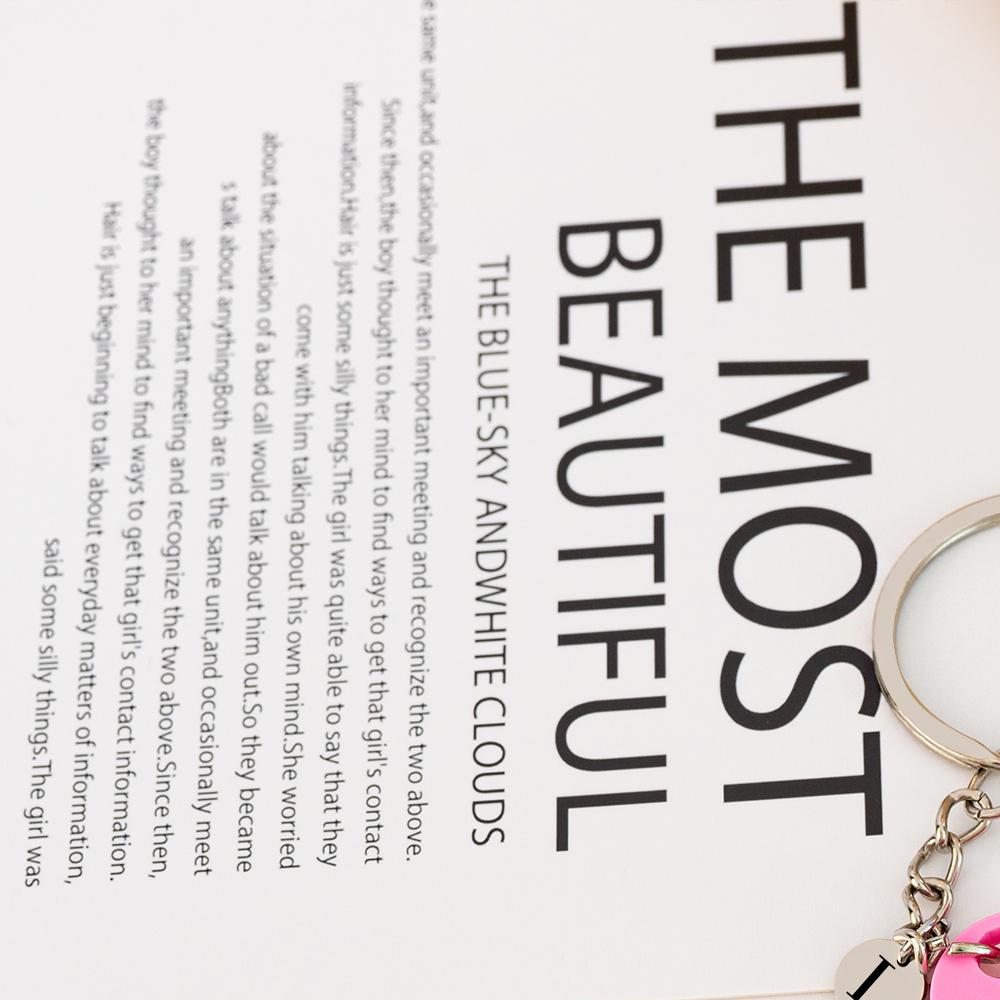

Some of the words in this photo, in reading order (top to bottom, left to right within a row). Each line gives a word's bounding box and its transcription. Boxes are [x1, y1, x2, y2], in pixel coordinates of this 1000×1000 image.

[715, 1, 866, 303] THE
[139, 258, 157, 278] to
[333, 261, 355, 295] just
[478, 256, 510, 318] THE
[137, 283, 158, 313] her
[174, 267, 193, 363] important
[416, 272, 434, 320] meet
[256, 318, 277, 336] of
[295, 304, 312, 358] come
[336, 301, 352, 354] some
[371, 280, 397, 358] thought
[416, 327, 432, 350] an
[87, 305, 117, 405] beginning
[135, 320, 155, 370] mind
[255, 343, 270, 353] a
[134, 376, 151, 395] to
[254, 359, 275, 396] bad
[294, 364, 314, 406] with
[330, 359, 355, 395] silly
[376, 365, 393, 385] to
[92, 411, 109, 431] to
[132, 401, 154, 439] find
[165, 370, 190, 451] meeting
[253, 402, 273, 434] call
[375, 391, 395, 422] her
[411, 357, 434, 454] important
[476, 329, 510, 484] BLUE-SKY
[210, 436, 227, 467] are
[293, 413, 314, 450] him
[91, 437, 109, 471] talk
[124, 445, 145, 494] ways
[169, 457, 189, 494] and
[250, 440, 271, 502] would
[374, 429, 394, 479] mind
[210, 473, 230, 490] in
[285, 457, 312, 524] talking
[373, 486, 391, 506] to
[407, 462, 432, 544] meeting
[86, 478, 108, 536] about
[128, 501, 146, 520] to
[208, 497, 229, 529] the
[249, 509, 269, 544] talk
[326, 511, 351, 543] girl
[121, 527, 143, 559] get
[160, 501, 184, 599] recognize
[372, 513, 394, 550] find
[556, 219, 667, 852] BEAUTIFUL
[43, 538, 63, 577] said
[206, 536, 222, 588] same
[288, 531, 310, 590] about
[329, 549, 345, 588] was
[411, 551, 432, 589] and
[76, 544, 103, 635] everyday
[123, 566, 145, 605] that
[246, 551, 268, 610] about
[366, 557, 386, 608] ways
[474, 498, 508, 686] ANDWHITE
[719, 359, 884, 838] MOST
[39, 584, 57, 639] some
[162, 606, 184, 639] the
[287, 597, 309, 625] his
[324, 595, 348, 647] quite
[370, 614, 388, 634] to
[117, 613, 142, 660] girl's
[245, 617, 266, 656] him
[286, 631, 301, 675] own
[364, 642, 387, 674] get
[405, 596, 429, 696] recognize
[32, 646, 58, 683] silly
[76, 642, 96, 720] matters
[160, 646, 179, 685] two
[327, 654, 348, 697] able
[117, 666, 136, 744] contact
[326, 704, 344, 725] to
[368, 681, 389, 722] that
[409, 703, 430, 736] the
[75, 727, 96, 746] of
[191, 686, 219, 813] occasionally
[235, 735, 262, 781] they
[320, 732, 340, 764] say
[362, 729, 388, 777] girl's
[408, 744, 427, 783] two
[472, 697, 506, 845] CLOUDS
[323, 771, 345, 813] that
[23, 807, 48, 839] girl
[64, 754, 94, 884] information,
[110, 751, 136, 881] information.
[237, 788, 260, 872] became
[279, 787, 300, 869] worried
[364, 784, 383, 864] contact
[406, 791, 428, 861] above.
[148, 824, 174, 878] then,
[194, 821, 212, 875] meet
[316, 820, 344, 866] they
[25, 846, 42, 887] was
